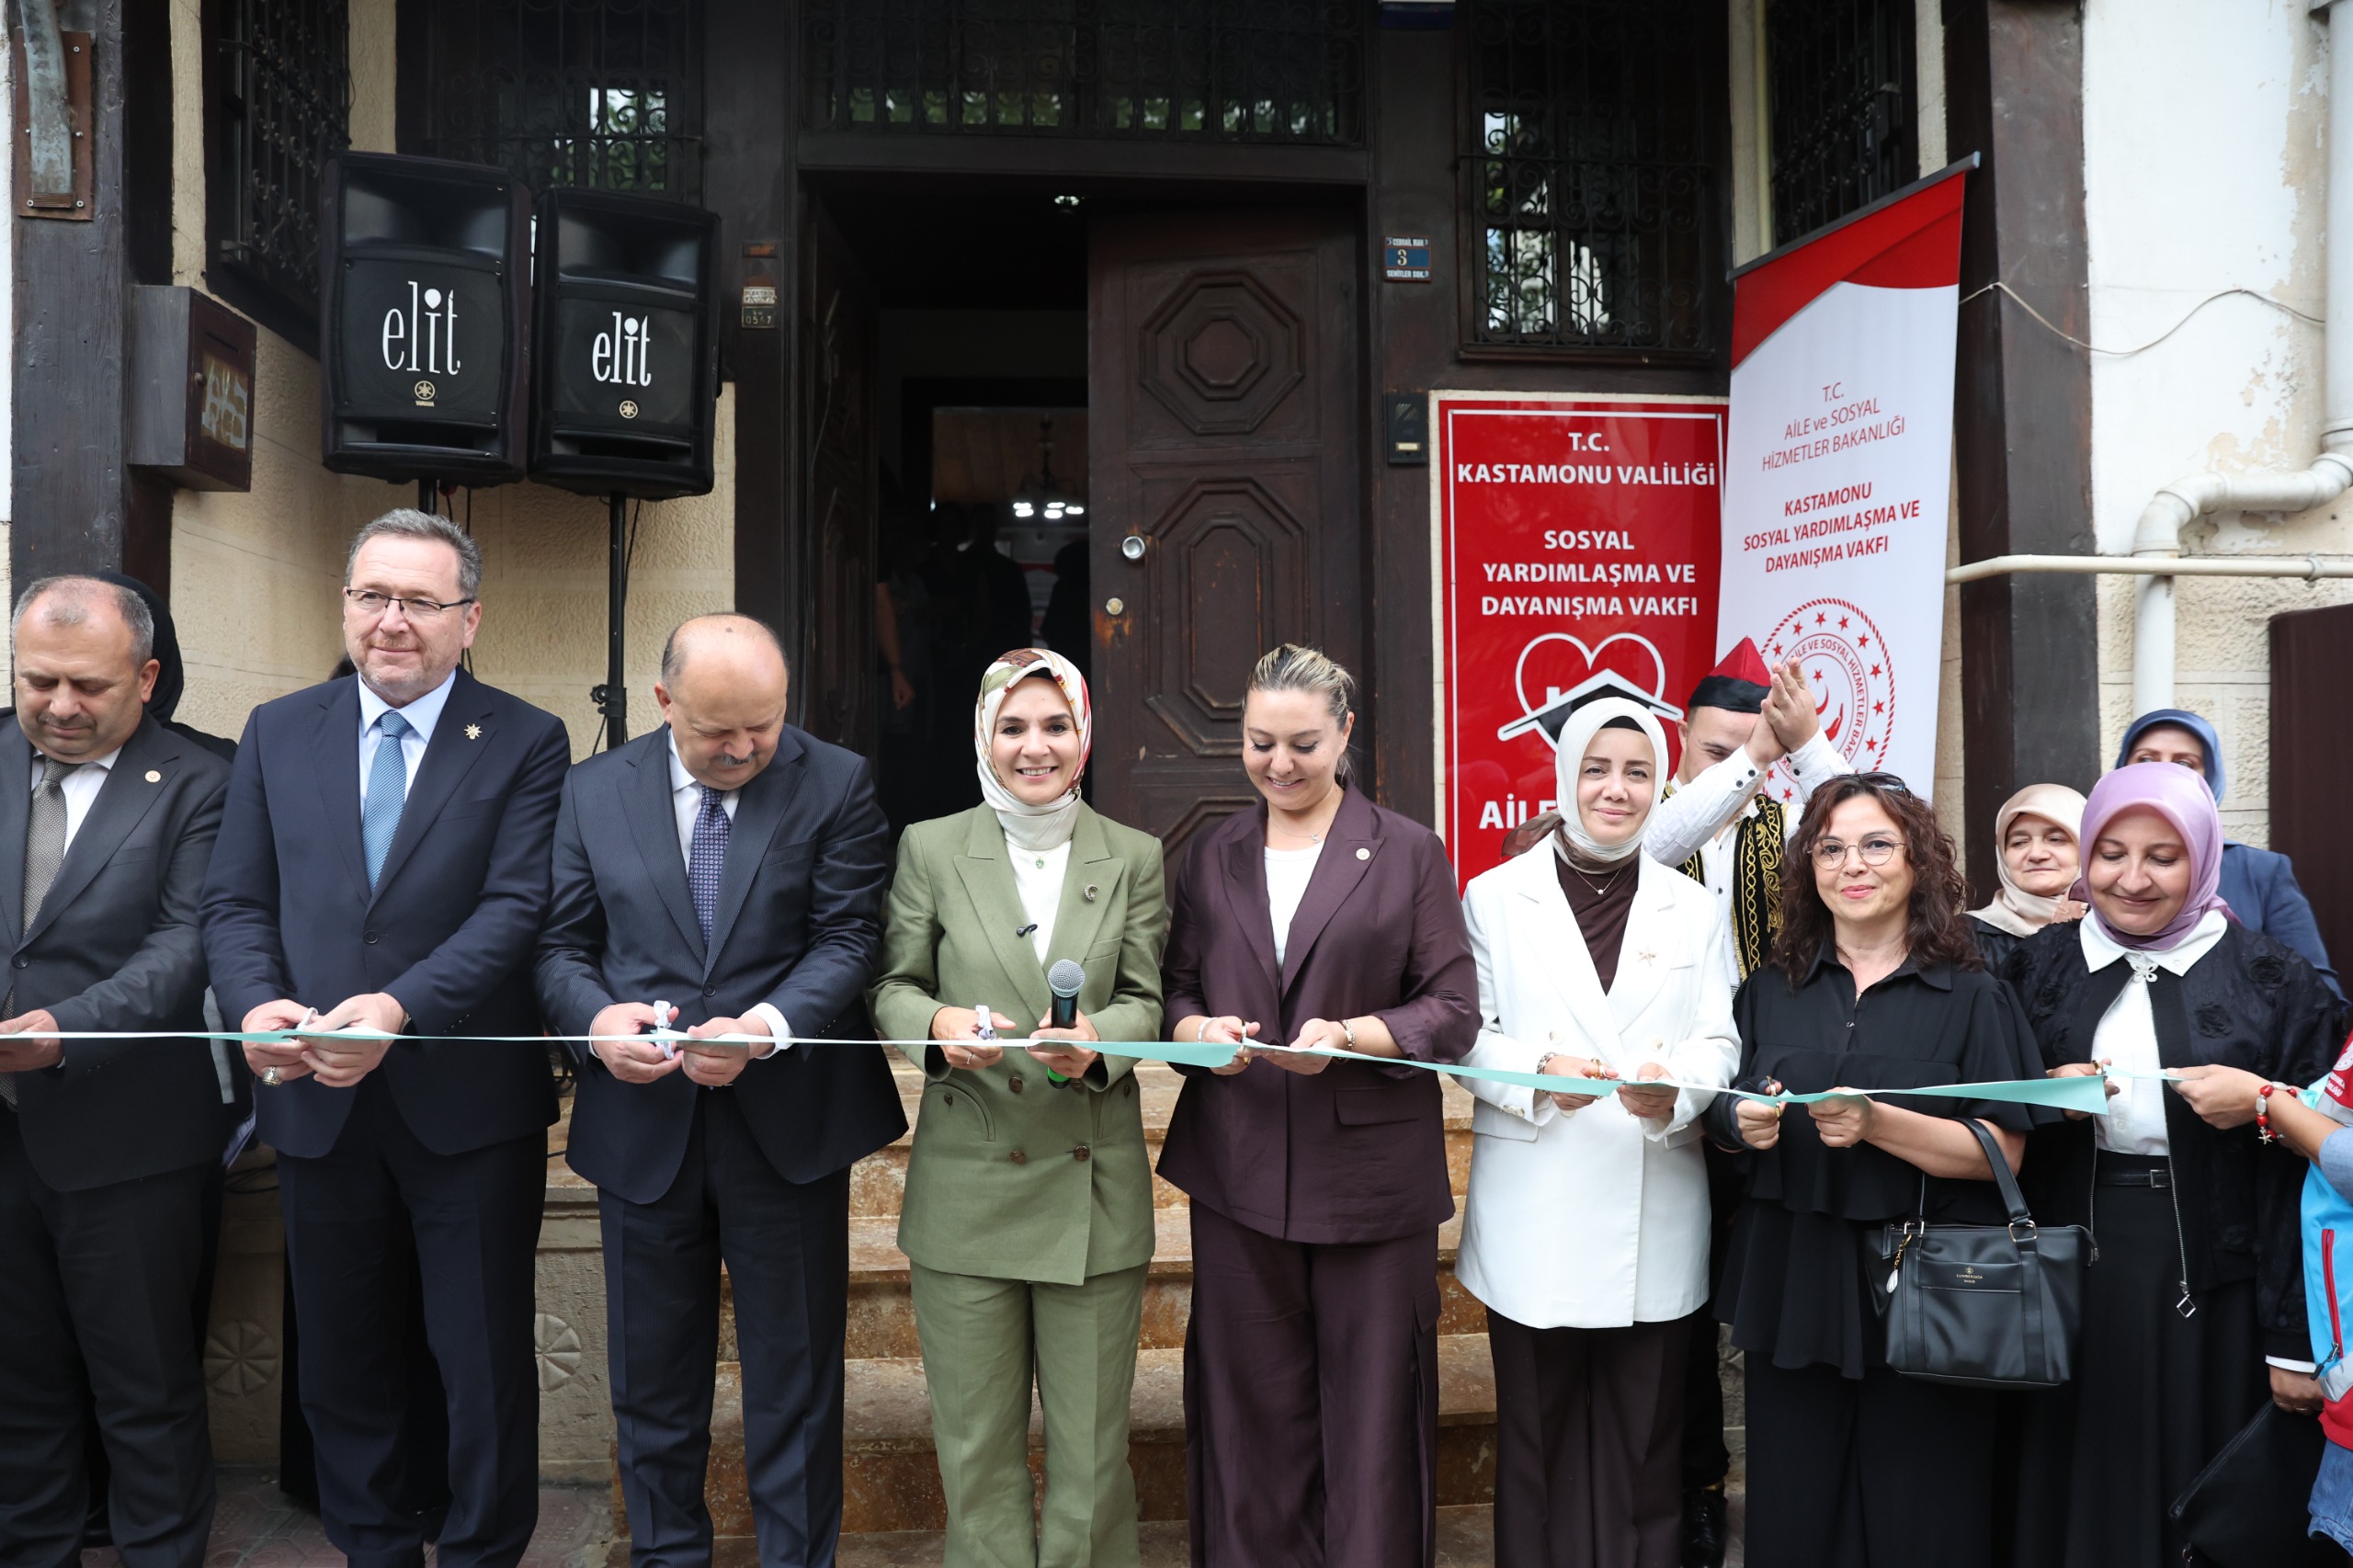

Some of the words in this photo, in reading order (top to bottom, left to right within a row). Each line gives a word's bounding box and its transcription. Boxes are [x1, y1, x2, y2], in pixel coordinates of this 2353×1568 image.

[1397, 249, 1407, 266] 3
[382, 280, 460, 375] elit
[592, 312, 652, 386] elit
[1823, 382, 1845, 402] T.C.
[1784, 418, 1811, 440] AİLE
[1813, 417, 1827, 432] ve
[1831, 398, 1881, 426] SOSYAL
[1568, 432, 1610, 451] T.C.
[1762, 438, 1829, 472] HİZMETLER
[1833, 415, 1905, 452] BAKANLIĞI
[1458, 463, 1612, 484] KASTAMONU
[1617, 461, 1716, 486] VALİLİĞİ
[1784, 482, 1872, 517] KASTAMONU
[1544, 530, 1635, 550] SOSYAL
[1744, 528, 1790, 551] SOSYAL
[1793, 505, 1897, 541] YARDIMLAŞMA
[1900, 500, 1920, 518] VE
[1765, 544, 1843, 574] DAYANIŞMA
[1847, 536, 1889, 558] VAKFI
[1483, 563, 1661, 587] YARDIMLAŞMA
[1665, 564, 1696, 583] VE
[1481, 597, 1623, 620] DAYANIŞMA
[1628, 597, 1698, 616] VAKFI
[1790, 643, 1807, 659] İLE
[1808, 639, 1819, 651] VE
[1821, 639, 1849, 662] SOSYAL
[1848, 658, 1865, 728] HİZMETLER
